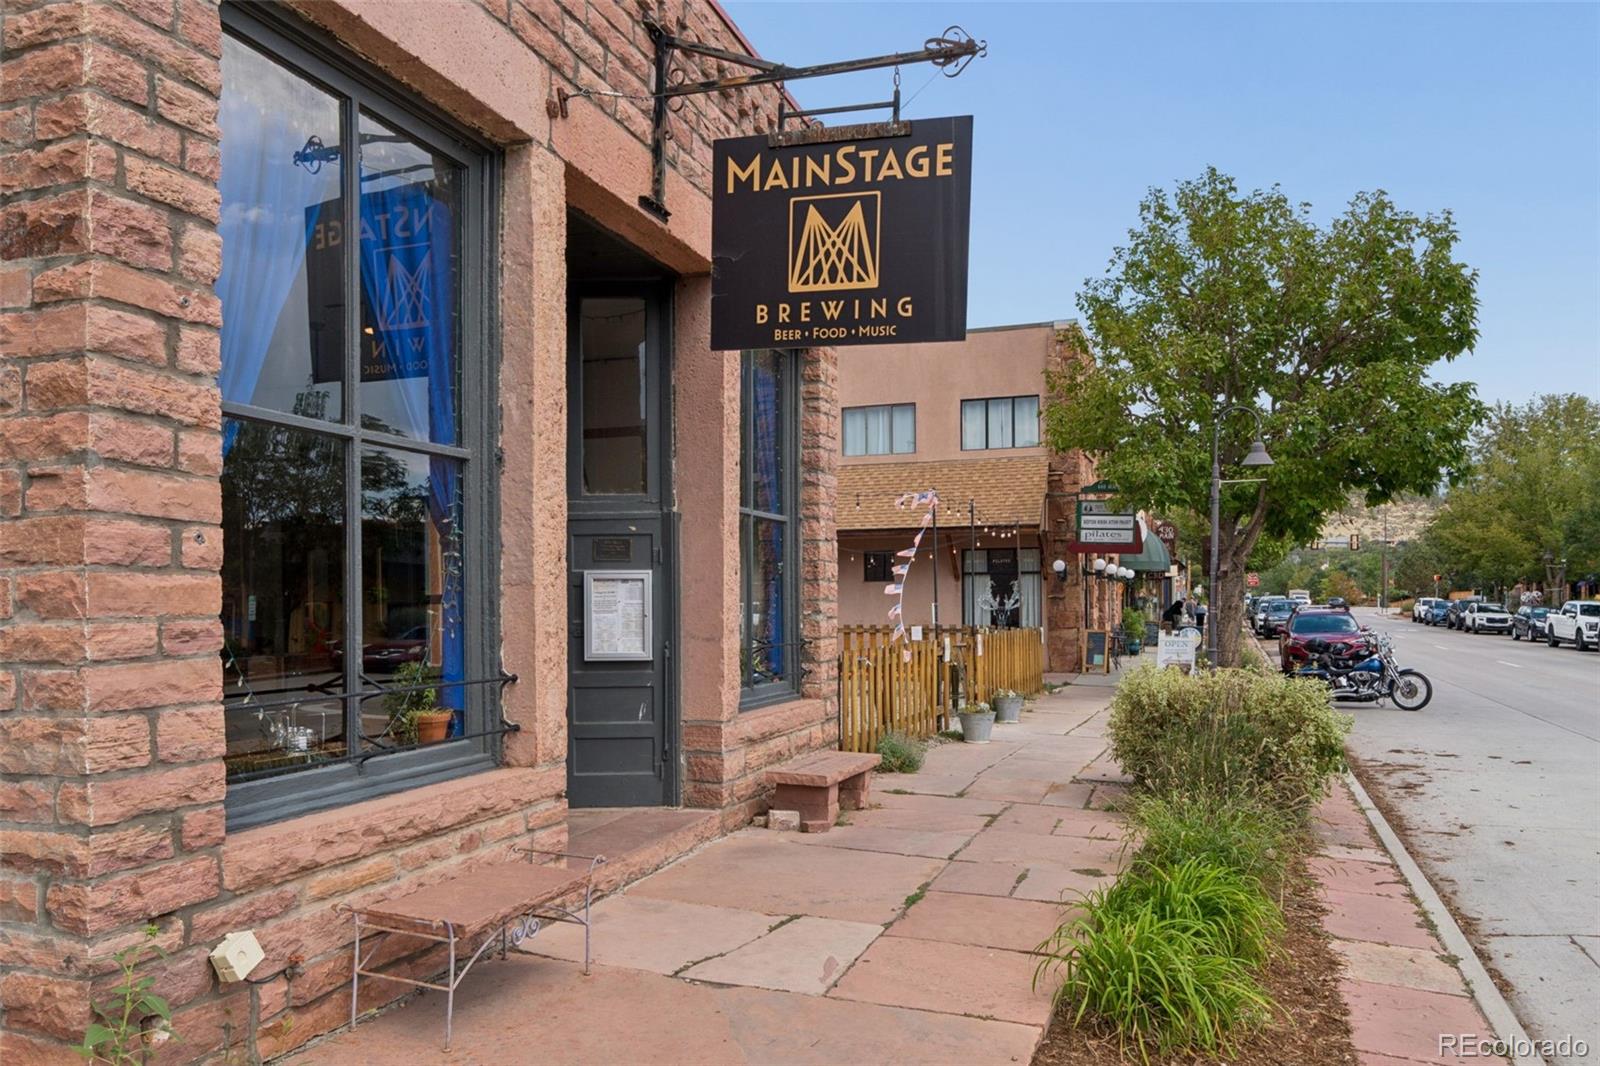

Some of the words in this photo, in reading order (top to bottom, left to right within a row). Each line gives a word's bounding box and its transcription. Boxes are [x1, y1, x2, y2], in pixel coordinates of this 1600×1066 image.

[727, 144, 954, 194] MAINSTAGE
[756, 296, 913, 324] BREWING
[774, 329, 802, 341] BEER
[813, 327, 848, 339] FOOD
[858, 325, 897, 337] MUSIC
[1084, 530, 1122, 541] pilates
